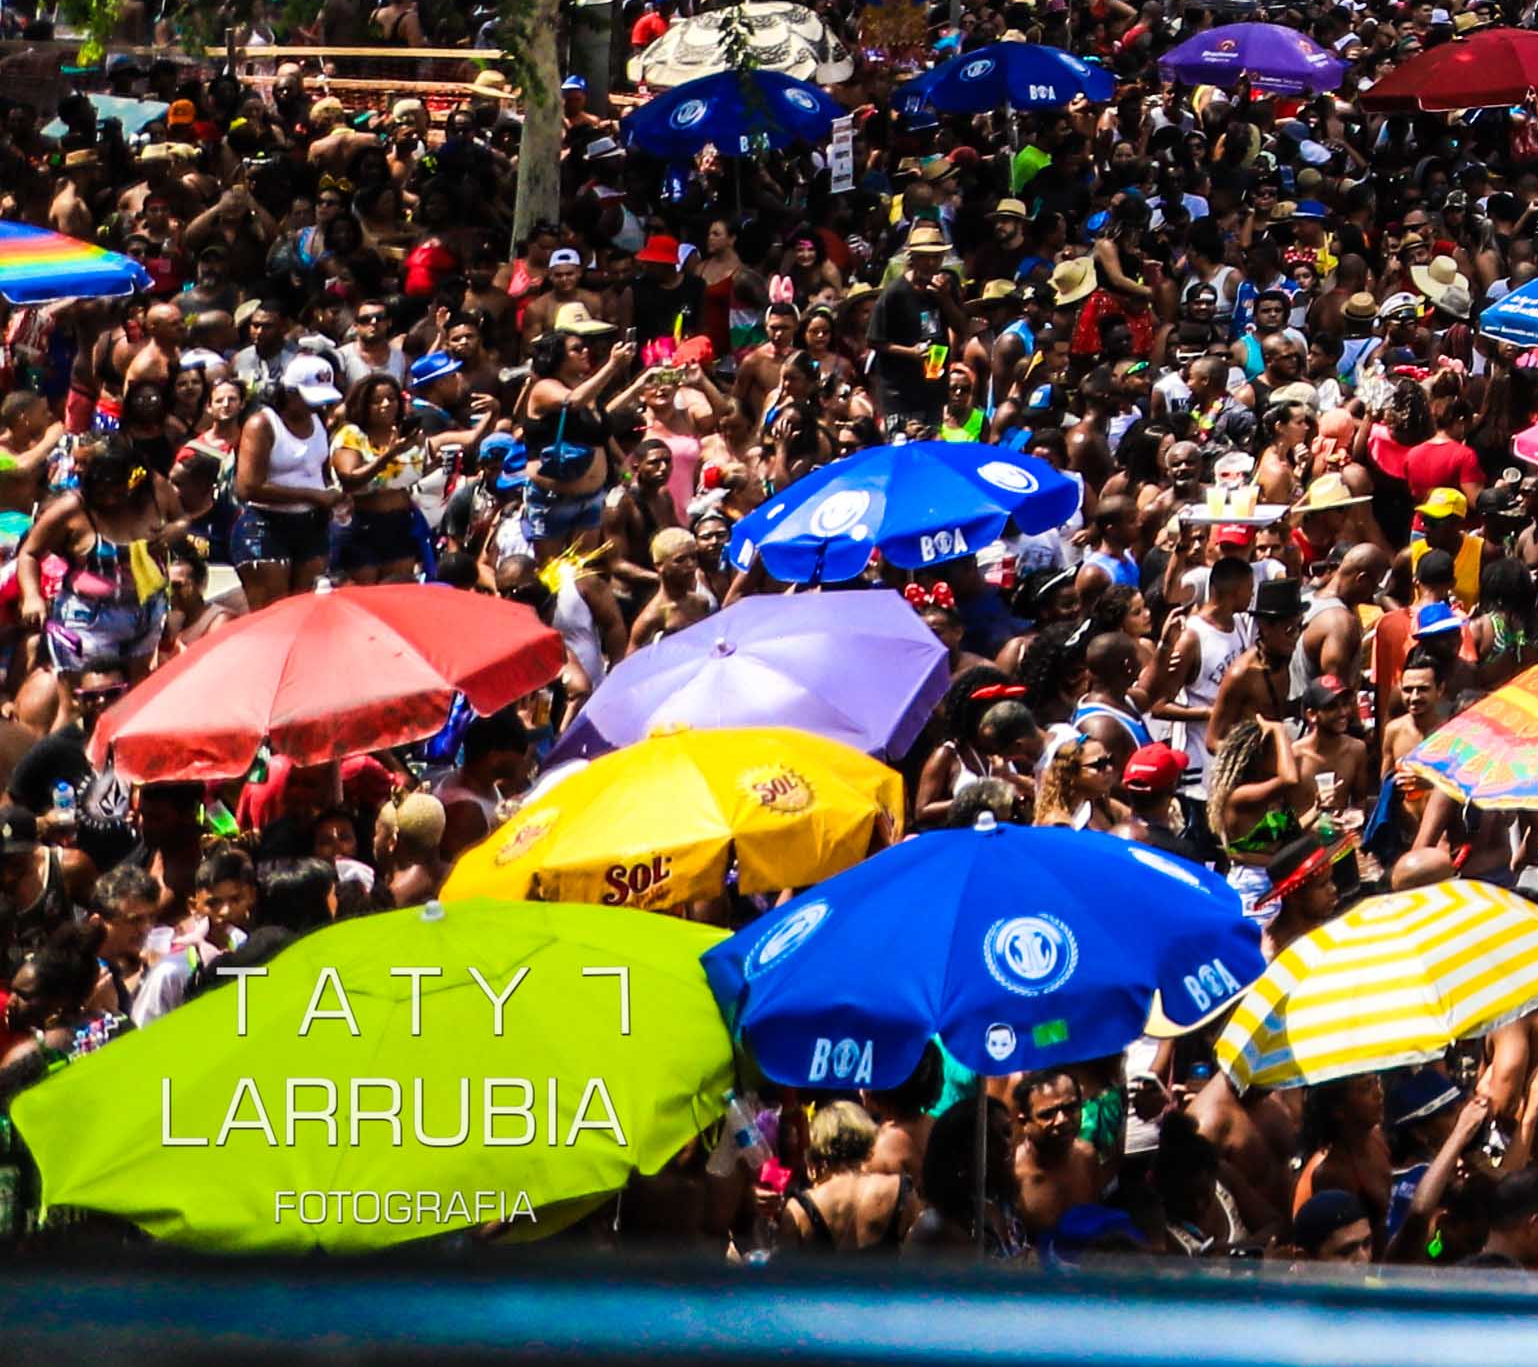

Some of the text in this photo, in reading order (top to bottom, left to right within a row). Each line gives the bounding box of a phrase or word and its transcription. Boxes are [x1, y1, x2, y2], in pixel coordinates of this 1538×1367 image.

[1029, 84, 1057, 101] BOA
[920, 528, 968, 562] BOA
[753, 771, 799, 807] SOL
[603, 853, 674, 907] SOL
[1183, 959, 1242, 1012] BOA
[810, 1038, 874, 1084] BOA
